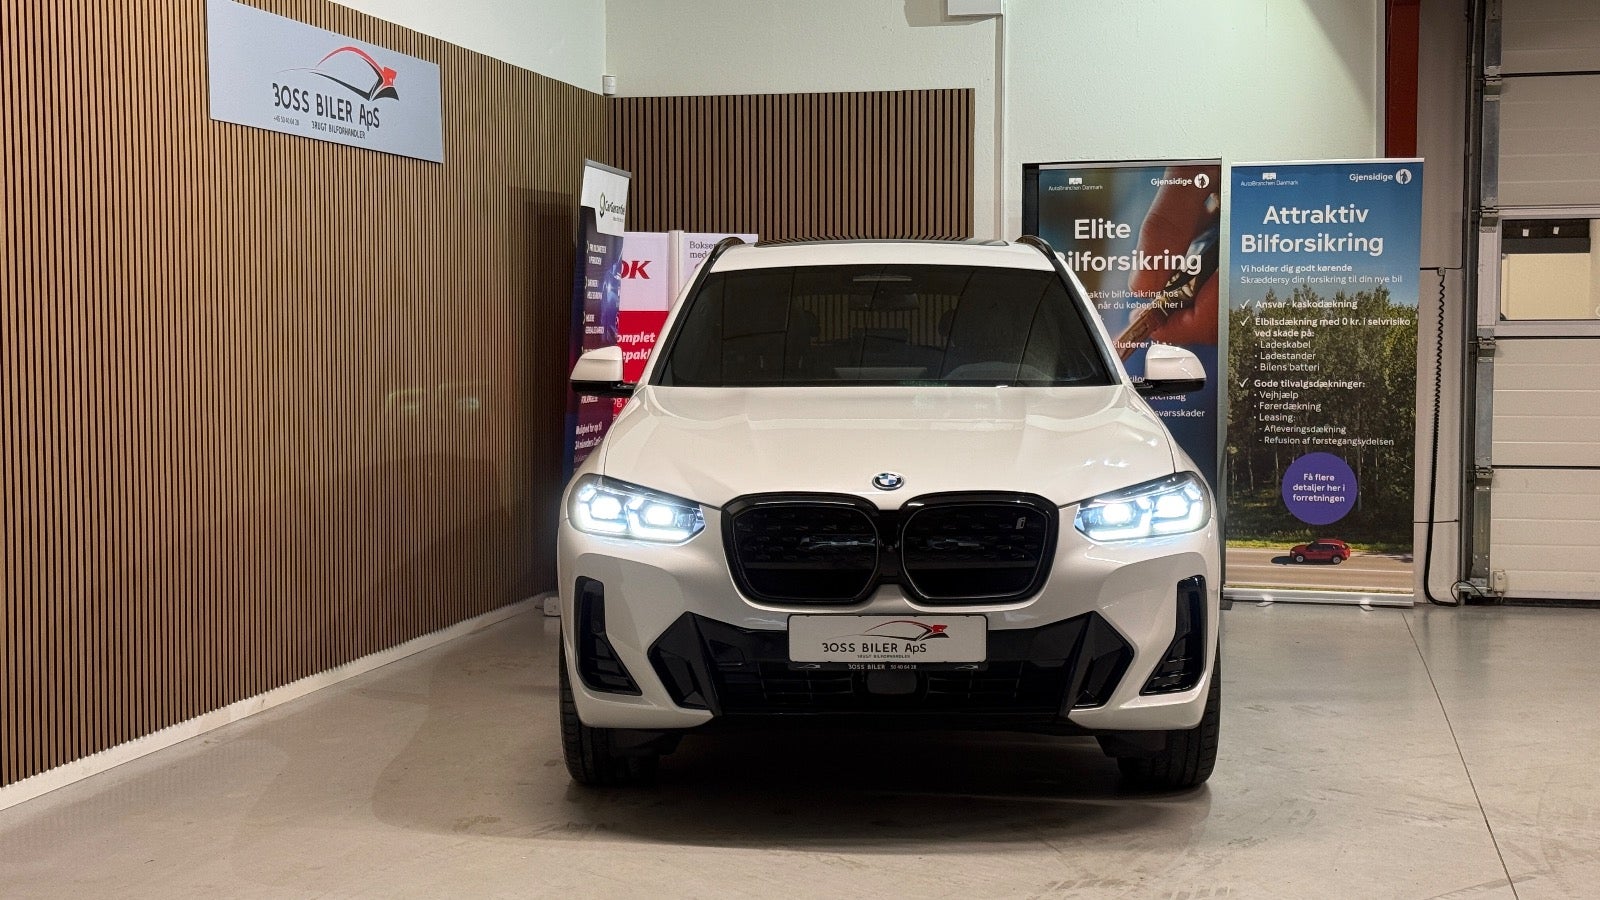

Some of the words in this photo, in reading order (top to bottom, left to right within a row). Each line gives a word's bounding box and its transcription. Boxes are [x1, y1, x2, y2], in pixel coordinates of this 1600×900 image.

[316, 94, 352, 123] BILER
[359, 104, 380, 131] ApS
[1150, 178, 1192, 186] Gjensidige
[1350, 174, 1393, 183] Gjensidige
[1263, 204, 1369, 224] Attraktiv
[1075, 218, 1131, 239] Elite
[1241, 233, 1383, 256] Bilforsikring
[1281, 265, 1294, 274] dig
[1296, 264, 1315, 274] godt
[1241, 276, 1290, 285] Skræddersy
[1308, 276, 1347, 285] forsikring
[1112, 289, 1161, 299] bilforsikring
[1098, 300, 1111, 309] når
[1126, 301, 1150, 309] køber
[1292, 300, 1358, 309] kaskodækning
[1255, 318, 1317, 327] Elbilsdækning
[1301, 329, 1314, 338] på:
[1254, 380, 1278, 388] Gode
[1281, 379, 1365, 389] tilvalgsdækninger:
[1260, 391, 1298, 400] Vejhjælp
[1259, 402, 1321, 412] Førerdækning
[1259, 414, 1296, 423] Leasing:
[1264, 425, 1346, 434] Afleveringsdækning
[1312, 437, 1394, 447] førstegangsydelsen
[1293, 484, 1324, 492] detaljer
[1293, 495, 1345, 503] forretningen
[862, 643, 898, 653] BILER
[905, 643, 926, 655] ApS
